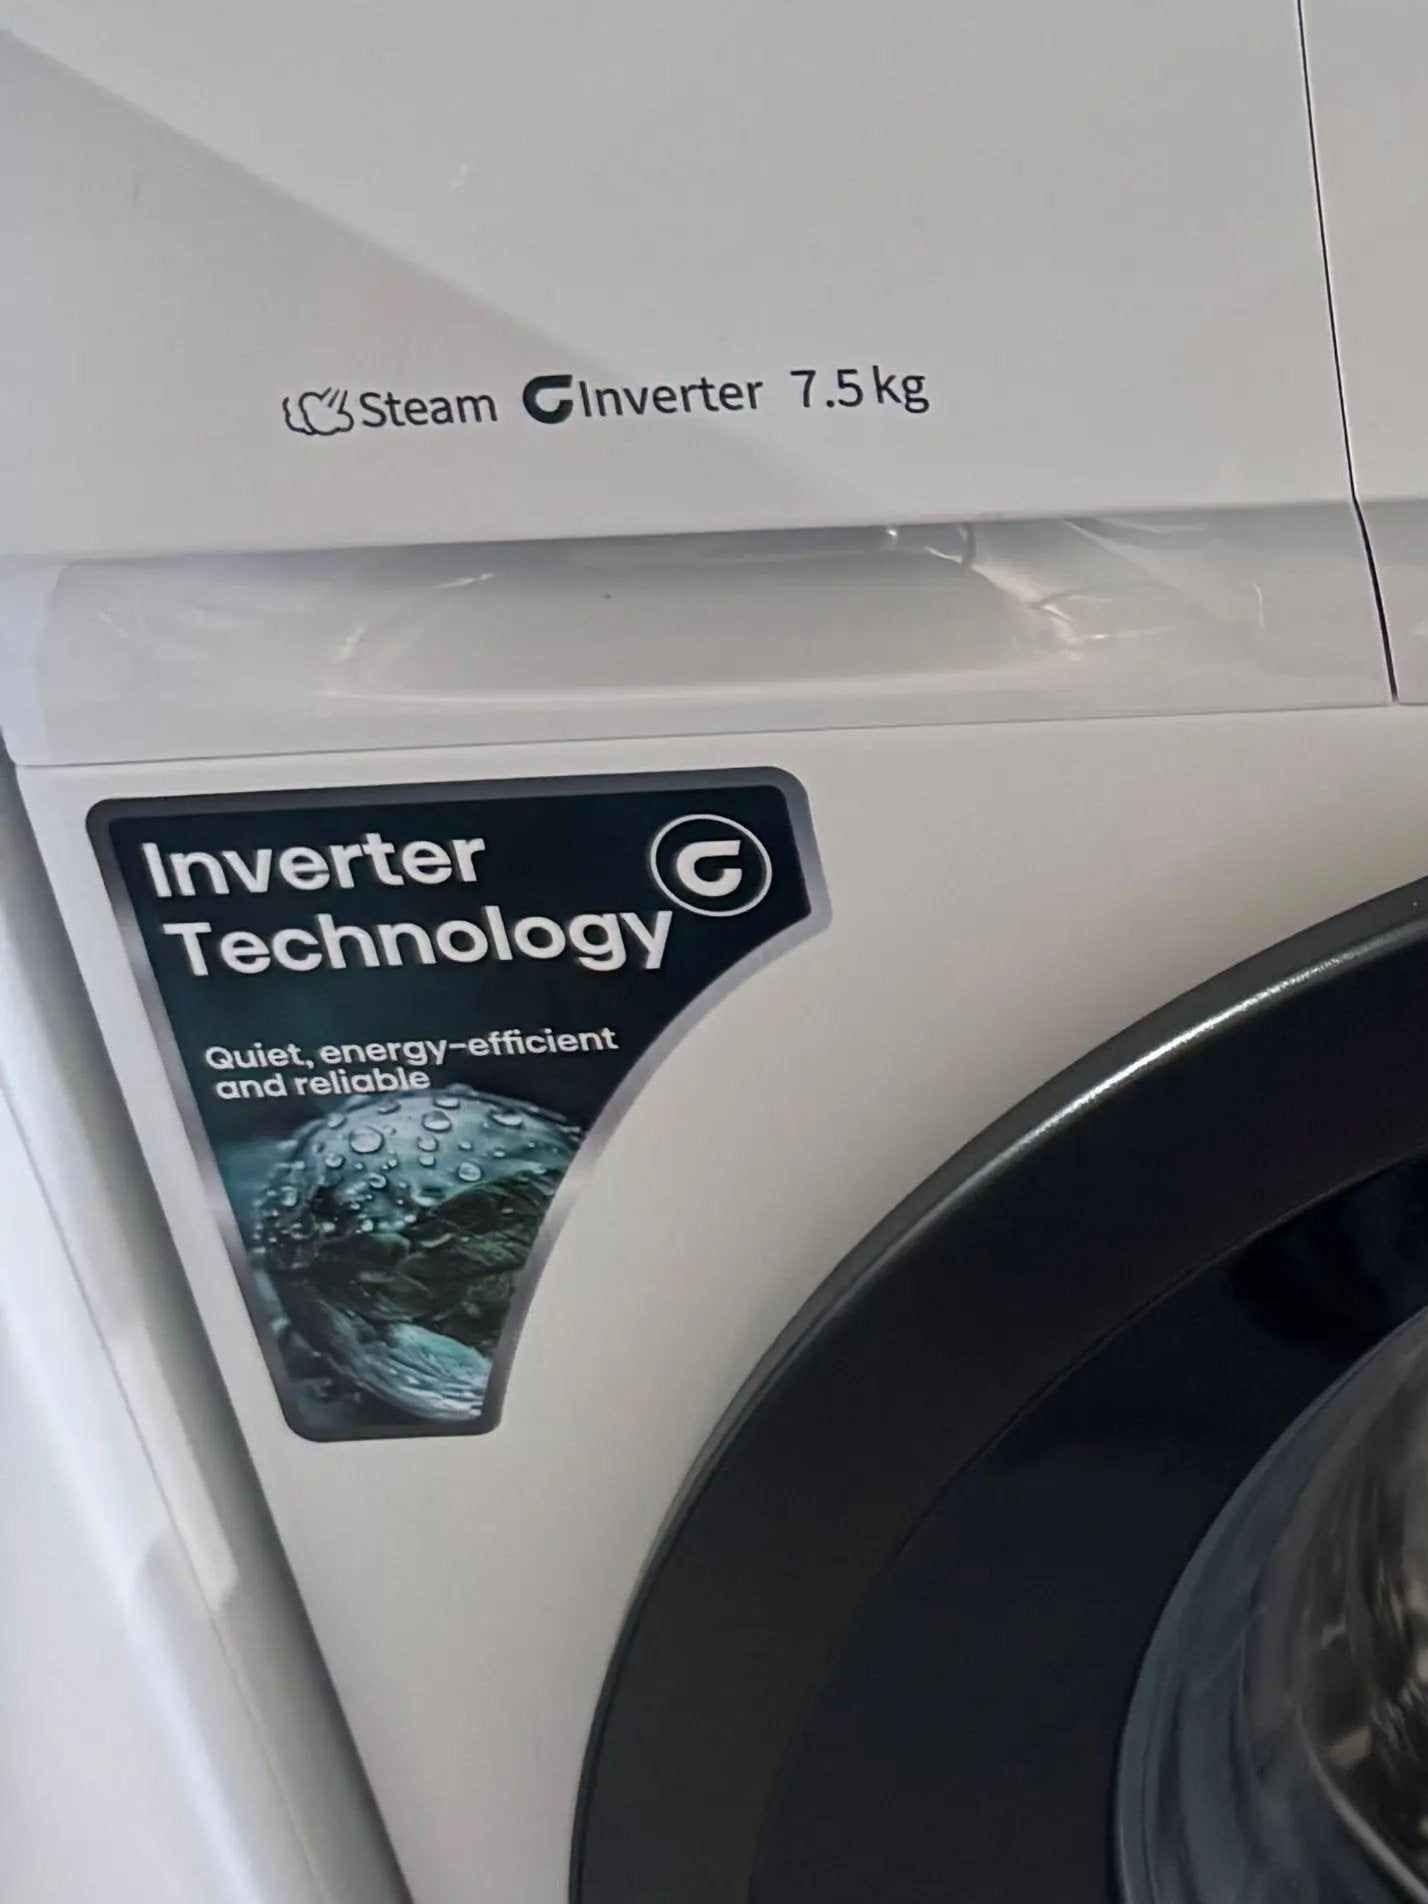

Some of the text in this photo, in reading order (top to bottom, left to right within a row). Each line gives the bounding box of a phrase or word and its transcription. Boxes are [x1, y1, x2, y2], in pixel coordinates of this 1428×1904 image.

[360, 392, 497, 427] Steam
[142, 833, 485, 897] Inverter
[163, 906, 672, 976] Technology
[205, 1028, 619, 1069] Quiet, energy-efficient
[215, 1067, 431, 1101] and reliable
